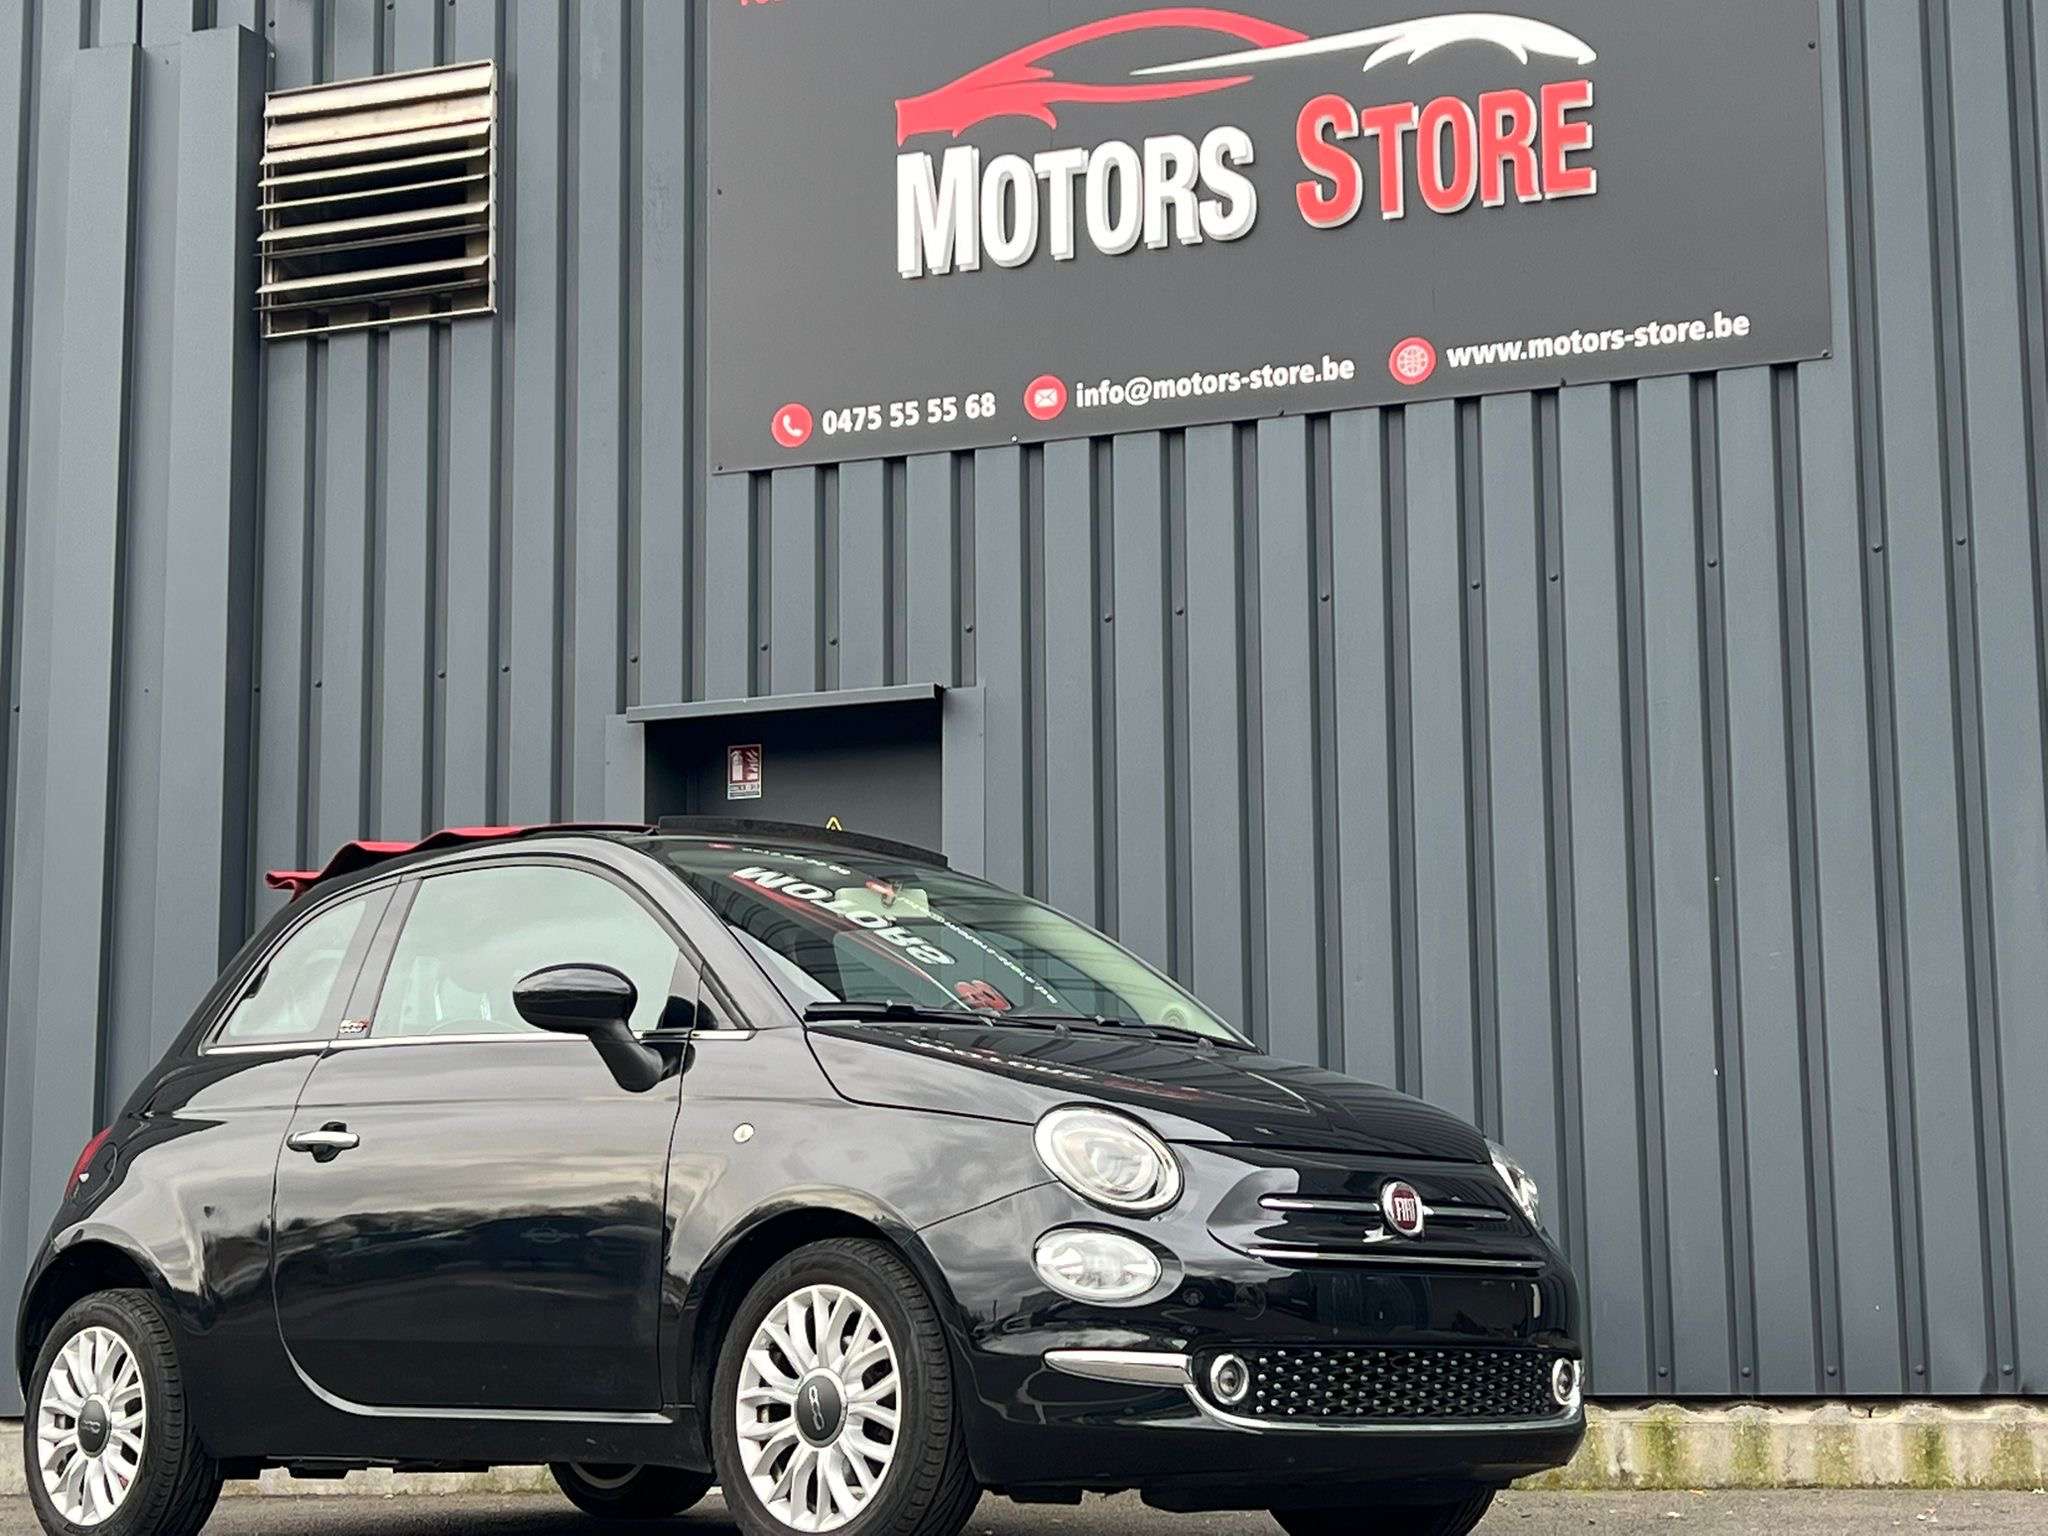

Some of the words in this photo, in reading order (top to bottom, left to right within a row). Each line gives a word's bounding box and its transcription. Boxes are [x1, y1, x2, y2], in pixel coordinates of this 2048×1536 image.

[896, 126, 1257, 279] MOTORS
[1296, 80, 1597, 229] STORE
[1446, 311, 1750, 368] www.motors-store.be
[1076, 355, 1356, 407] info@motors-store.be
[822, 405, 882, 435] 0475
[889, 400, 920, 428] 55
[927, 396, 958, 423] 55
[964, 392, 996, 419] 68
